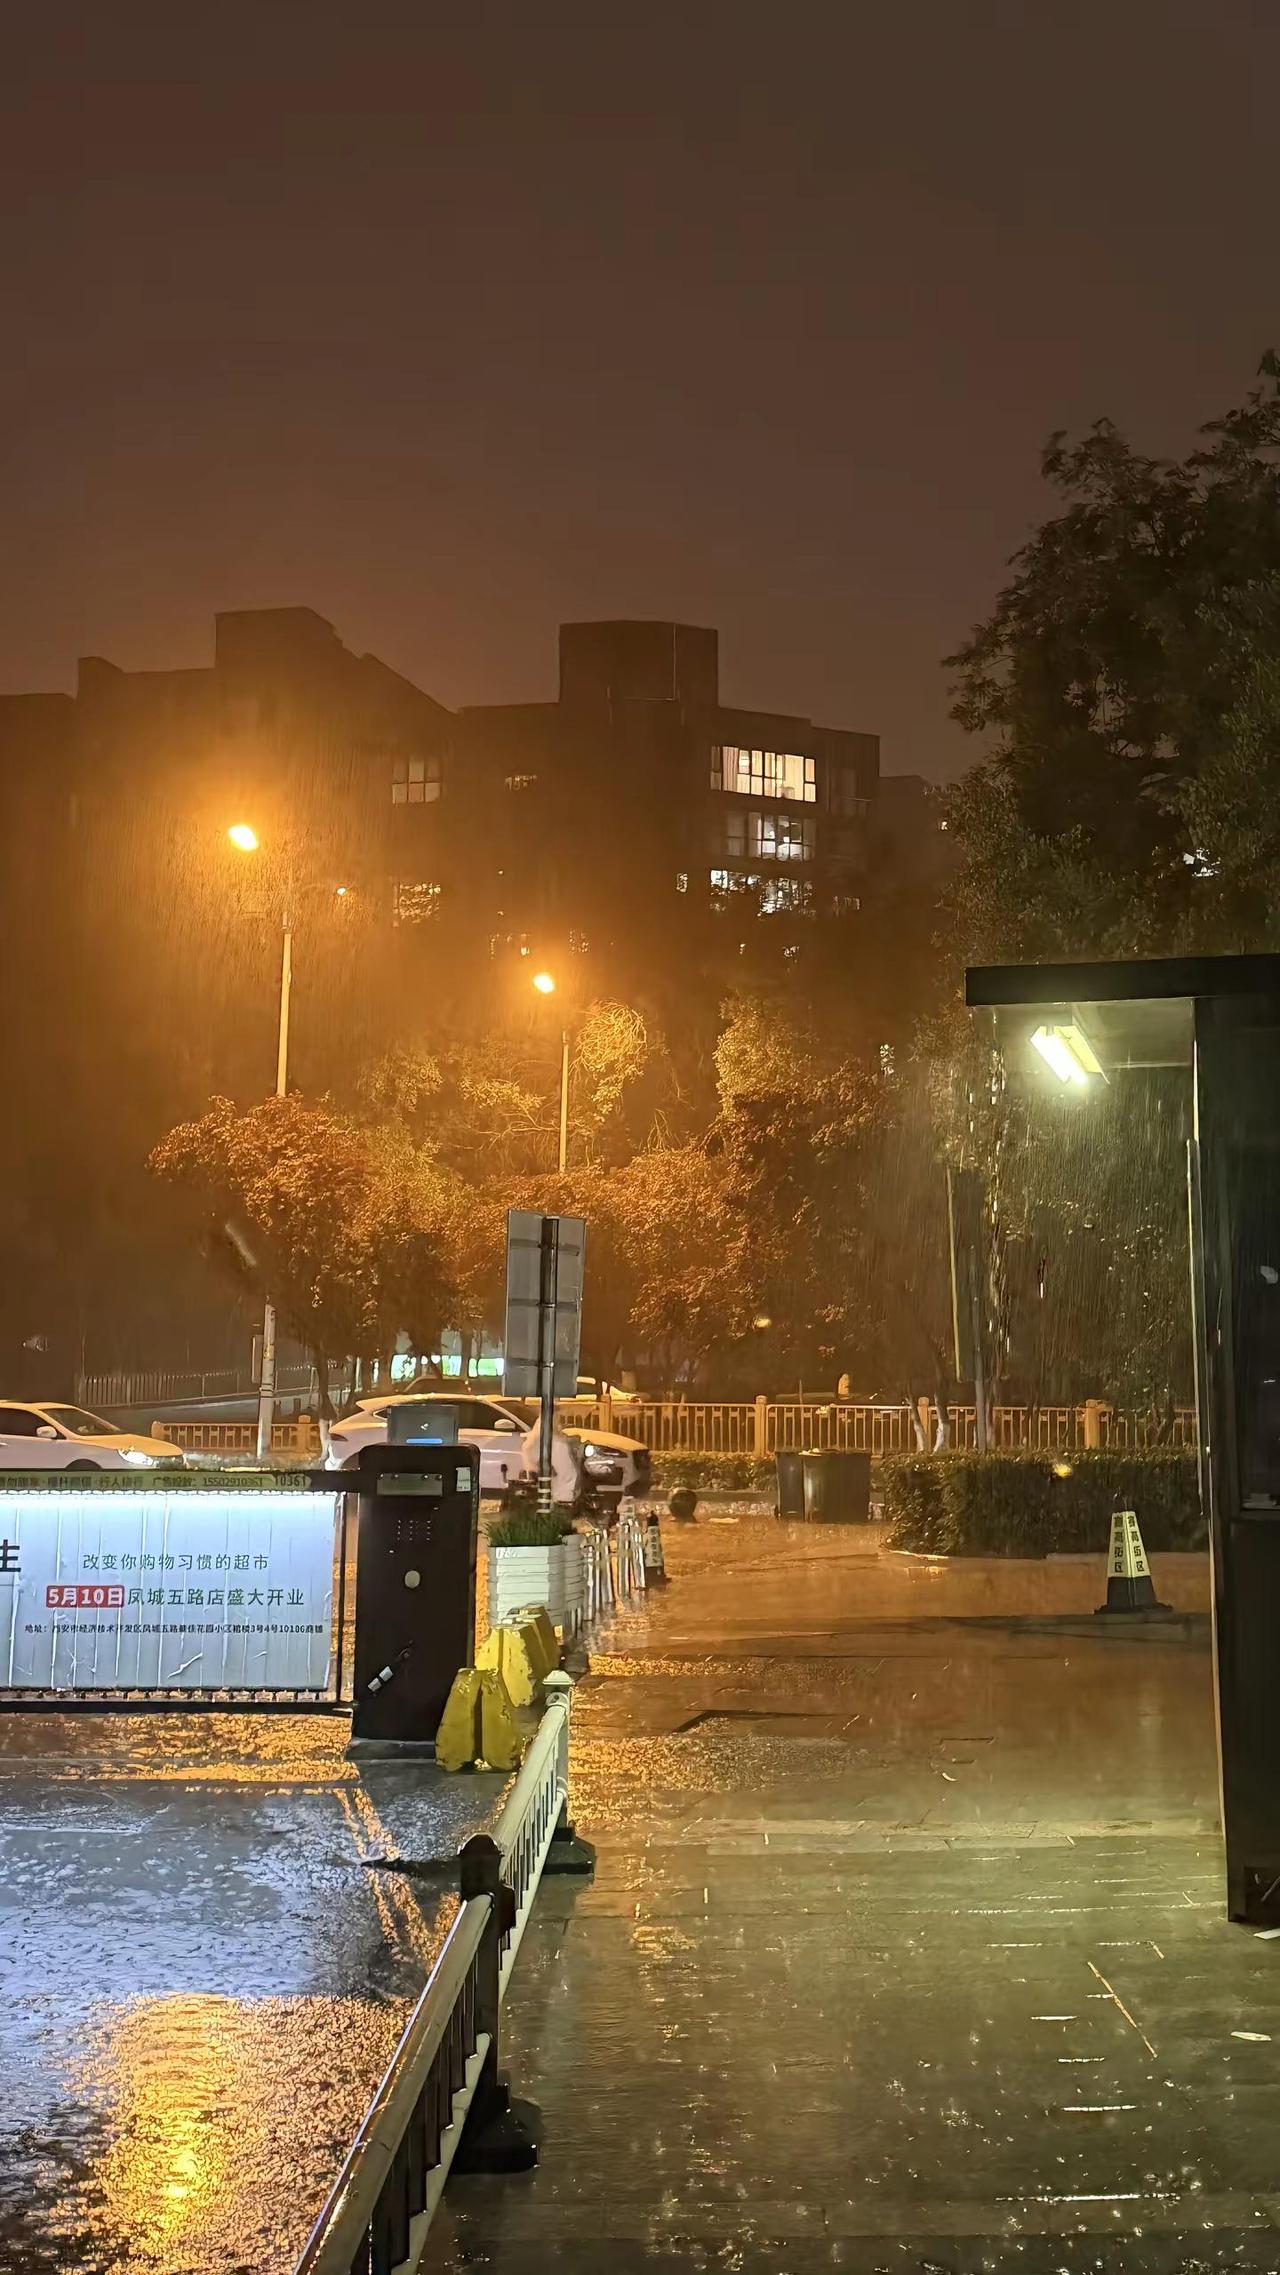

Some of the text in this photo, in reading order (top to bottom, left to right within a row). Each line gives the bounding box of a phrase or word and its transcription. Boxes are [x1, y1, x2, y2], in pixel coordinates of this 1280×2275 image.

[82, 1553, 270, 1571] 改变你购物习惯的超市
[48, 1587, 305, 1606] 5月10日 凤城五路店盛大开业
